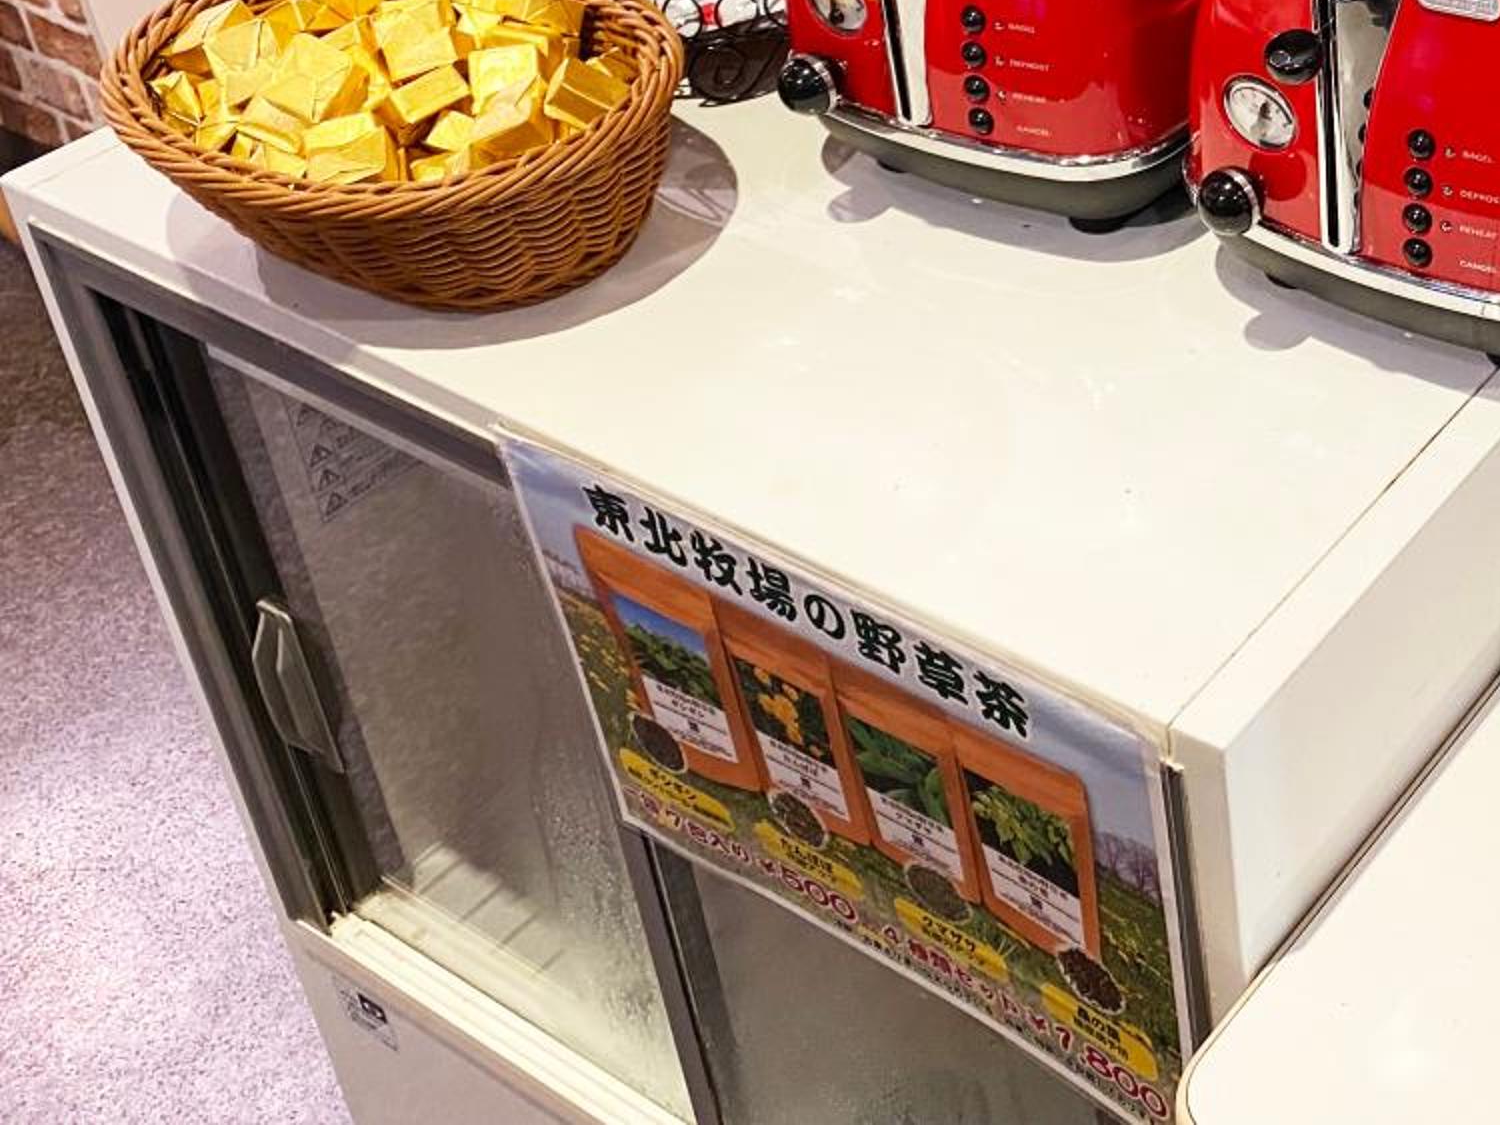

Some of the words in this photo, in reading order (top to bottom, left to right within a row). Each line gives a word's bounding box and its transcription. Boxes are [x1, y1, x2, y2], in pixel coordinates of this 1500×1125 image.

[582, 484, 1029, 739] 東北牧場の野草茶
